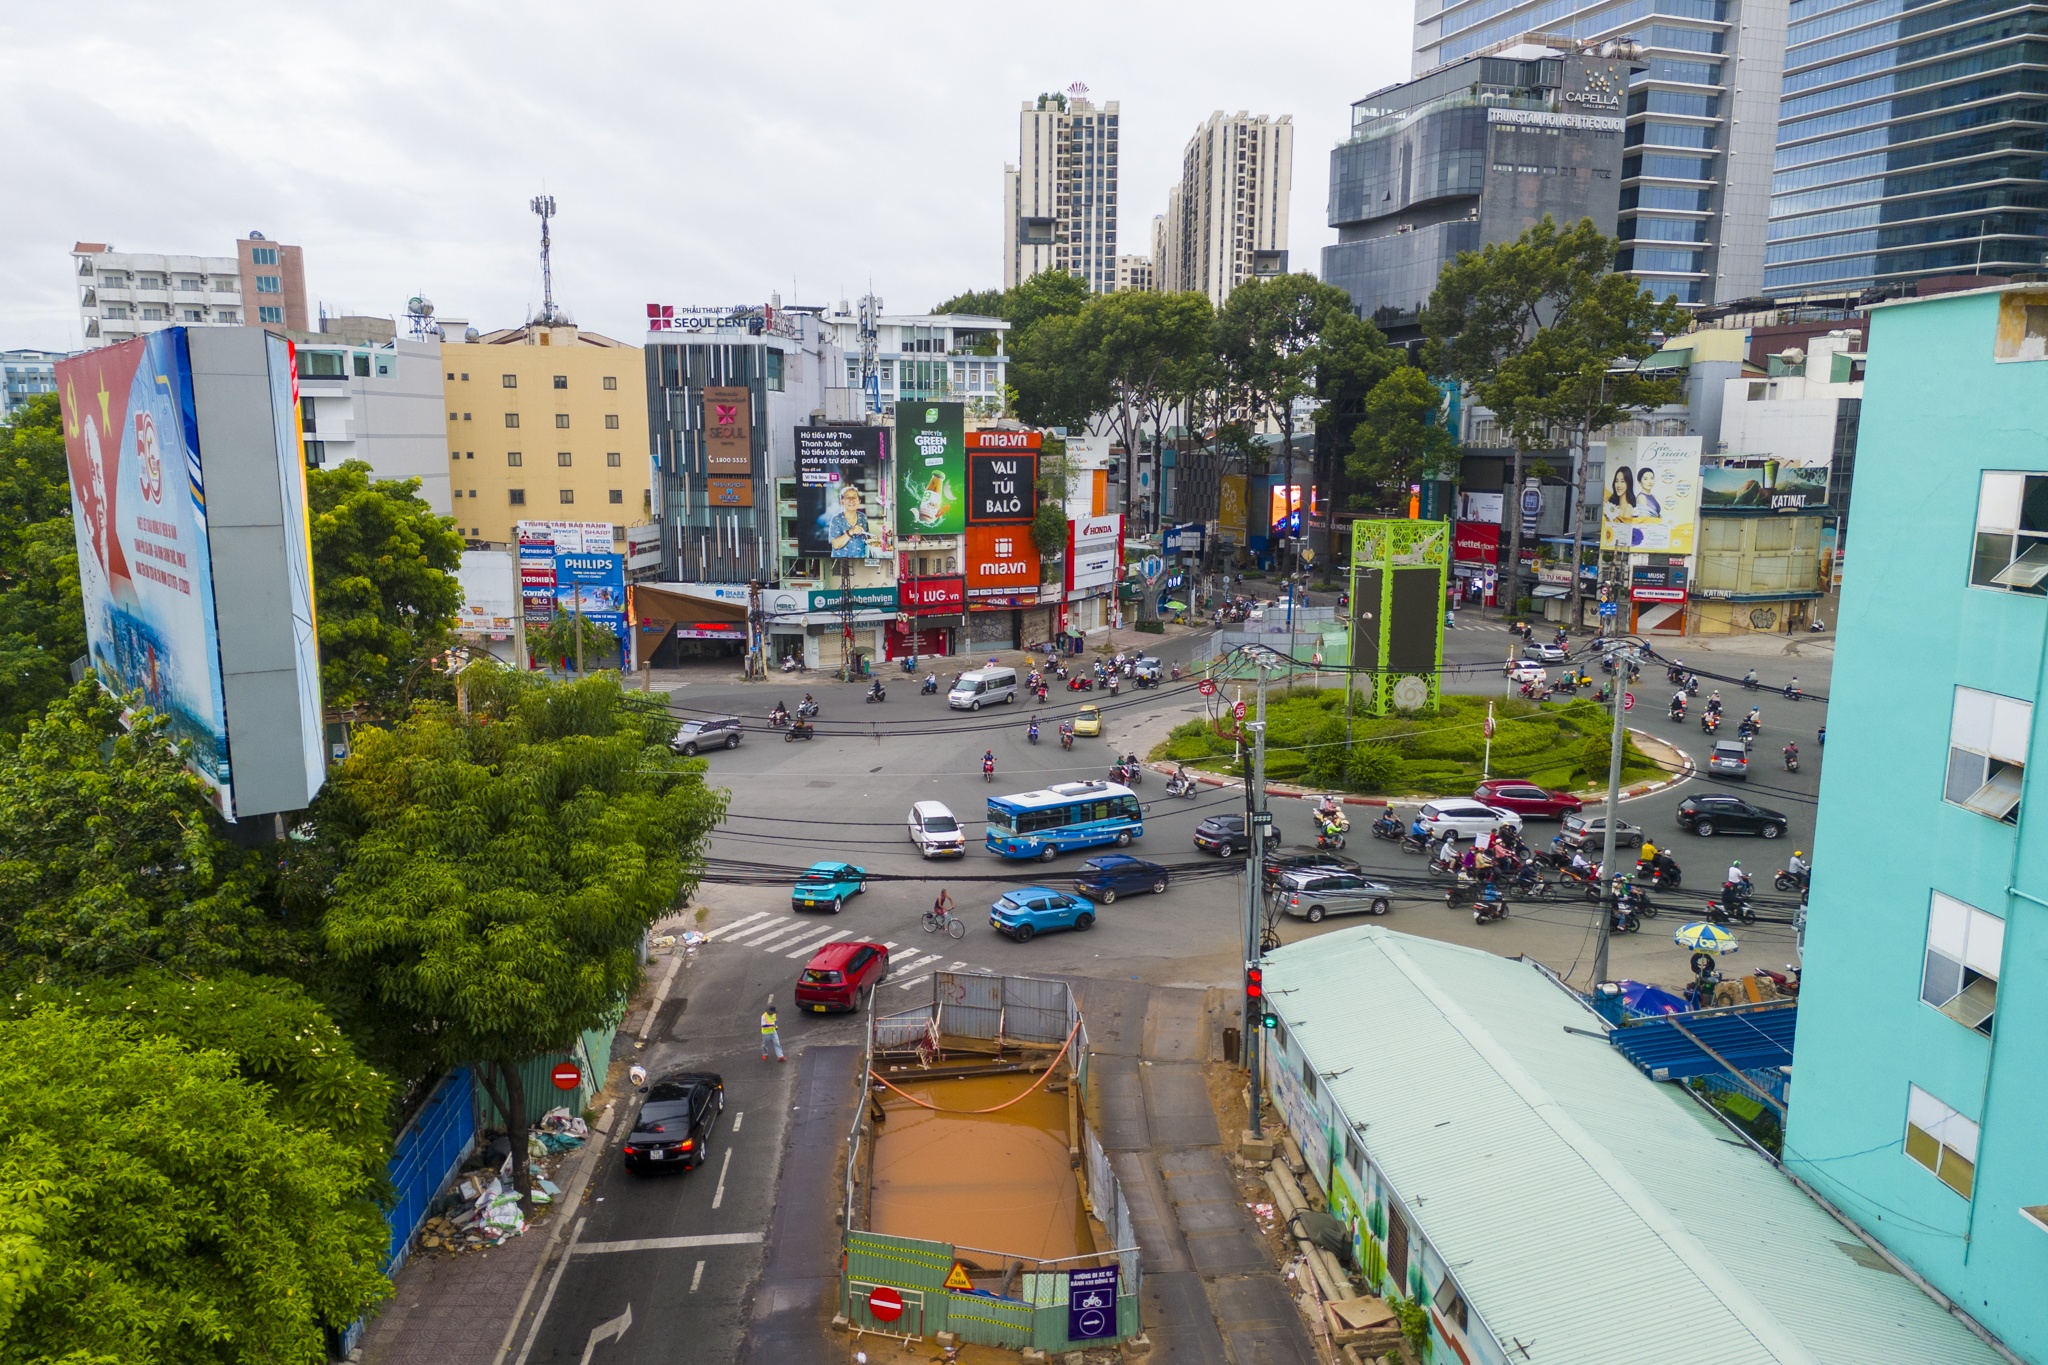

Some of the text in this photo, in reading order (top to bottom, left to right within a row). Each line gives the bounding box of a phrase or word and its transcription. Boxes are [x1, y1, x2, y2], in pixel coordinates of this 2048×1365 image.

[1566, 92, 1619, 105] CAPELLA
[1491, 111, 1521, 122] TRUNG
[674, 318, 715, 328] SEOUL
[716, 318, 765, 329] CENTER
[709, 428, 747, 439] SEOUL
[914, 436, 947, 446] GREEN
[980, 434, 1027, 447] mia.vn
[921, 445, 944, 455] BIRD
[991, 461, 1017, 474] VALI
[992, 477, 1014, 494] TÚI
[986, 495, 1021, 513] BALÔ
[1770, 495, 1806, 509] KATINAT
[1089, 525, 1112, 535] HONDA
[1457, 539, 1481, 549] viettel
[520, 547, 553, 555] Panasonic
[565, 558, 613, 570] PHILIPS
[980, 562, 1027, 575] mia.vn
[521, 576, 555, 584] TOSHIBA
[1703, 589, 1733, 599] KATINAT
[1699, 936, 1717, 948] be
